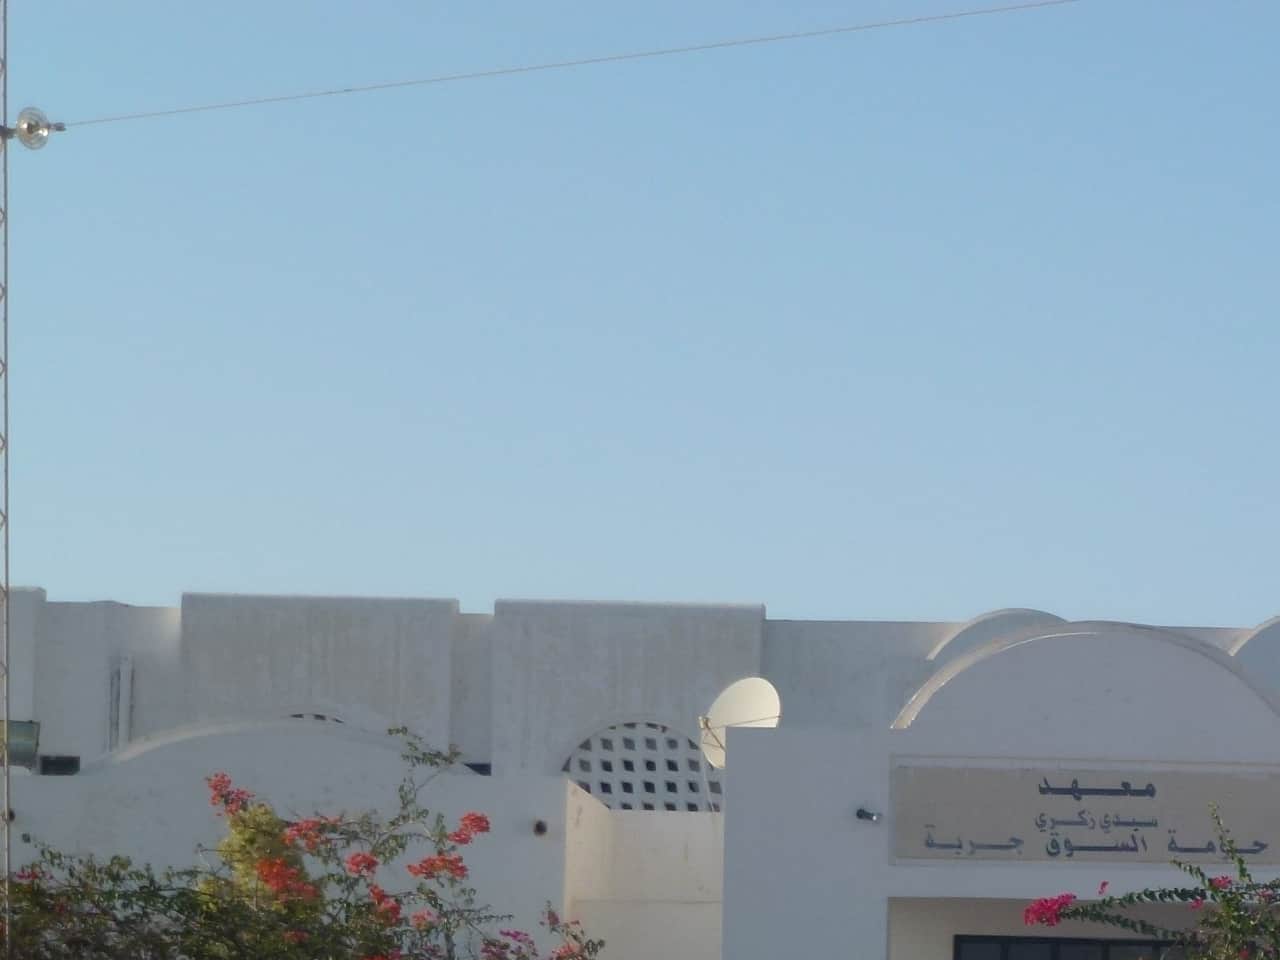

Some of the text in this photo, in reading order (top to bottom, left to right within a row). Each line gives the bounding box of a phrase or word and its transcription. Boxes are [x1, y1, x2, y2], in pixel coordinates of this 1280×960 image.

[1038, 777, 1157, 801] معهد
[1099, 813, 1158, 833] سيدي
[923, 824, 1025, 855] جربة
[1046, 831, 1147, 857] السوق
